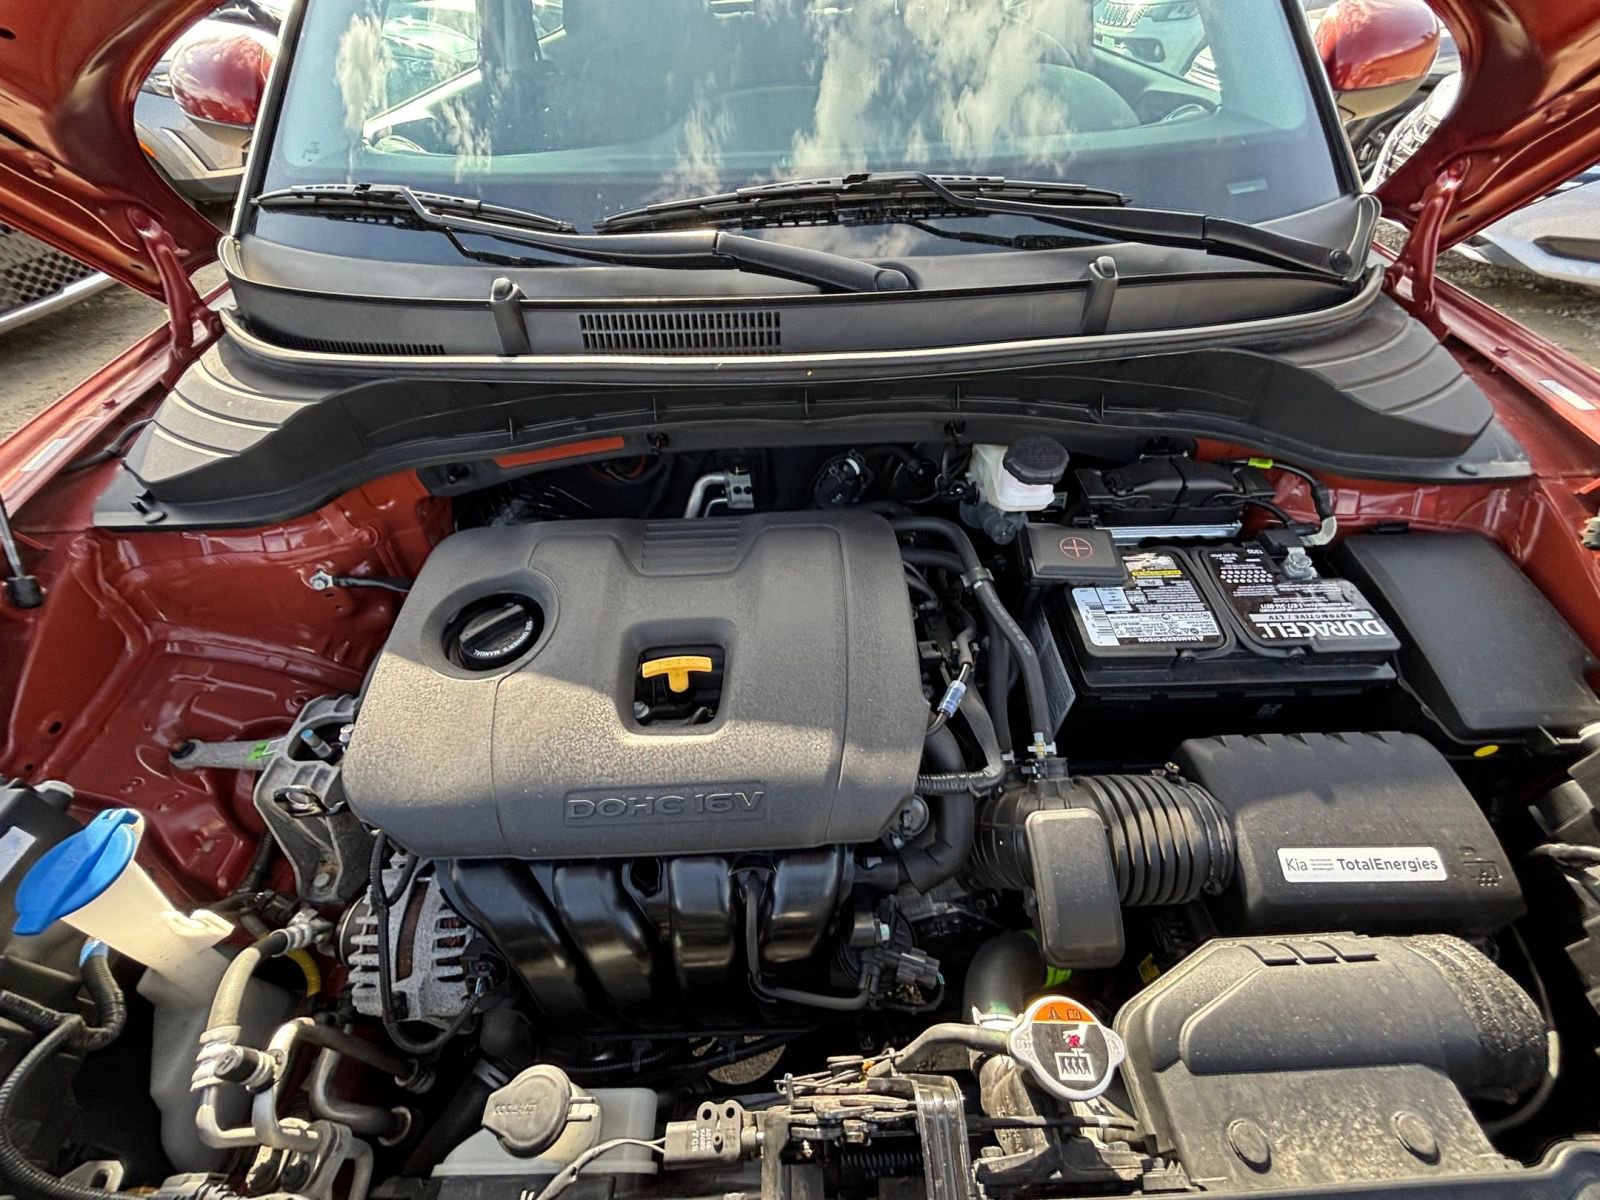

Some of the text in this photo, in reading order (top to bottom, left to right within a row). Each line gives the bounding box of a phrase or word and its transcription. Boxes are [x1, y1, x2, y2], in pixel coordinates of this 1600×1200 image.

[1294, 612, 1353, 621] AUTOMOTIVE
[1256, 619, 1387, 639] DURACELL
[473, 649, 501, 657] MANUAL
[567, 790, 765, 819] DOHC 16V
[1285, 857, 1438, 873] Kia TotalEnergies
